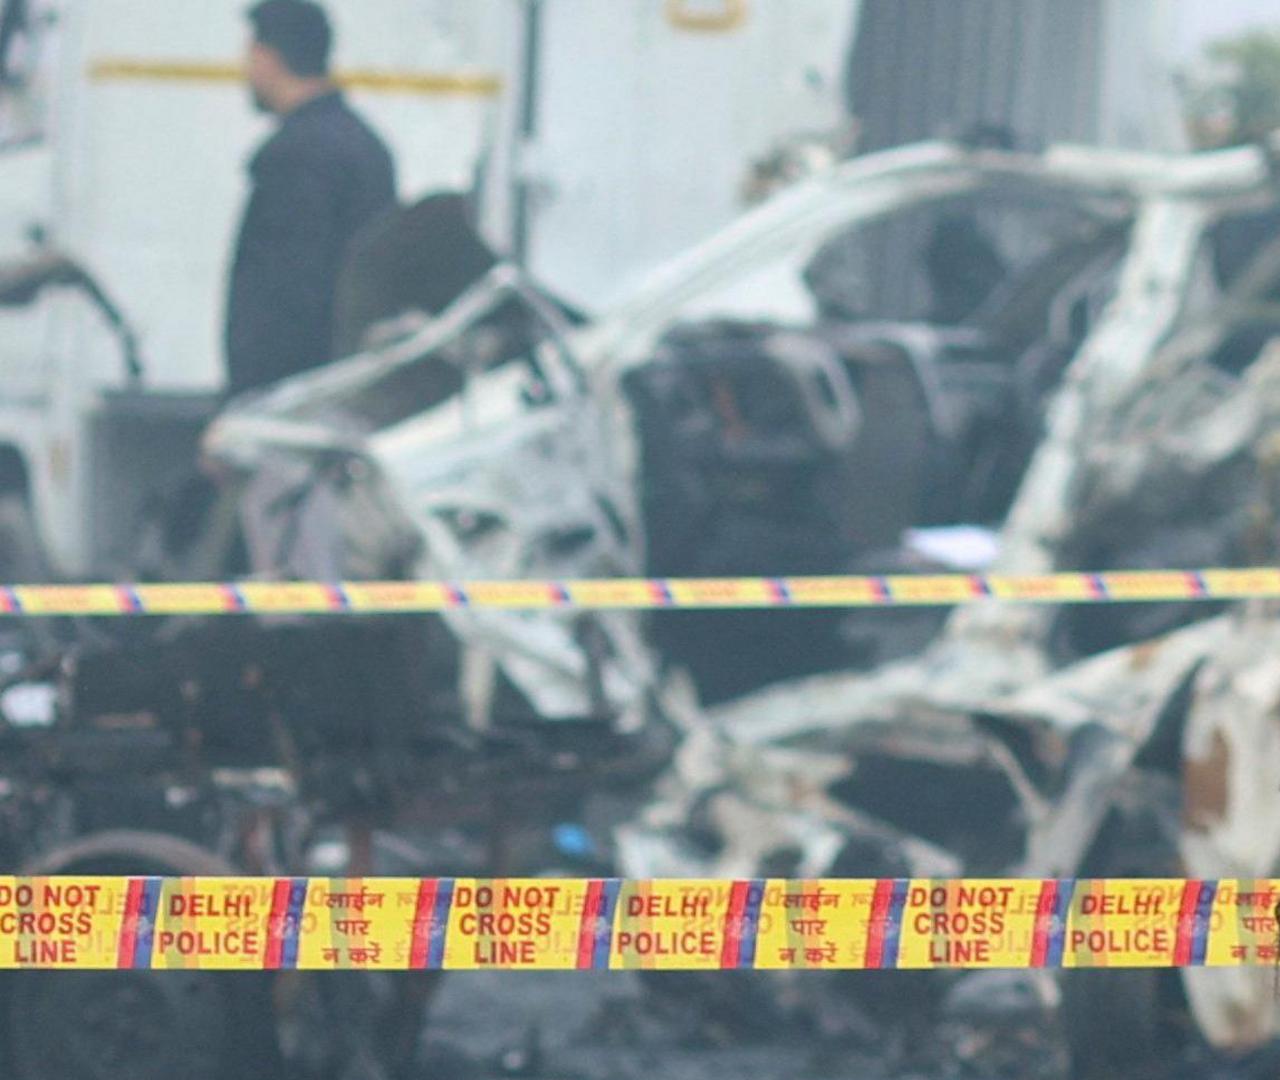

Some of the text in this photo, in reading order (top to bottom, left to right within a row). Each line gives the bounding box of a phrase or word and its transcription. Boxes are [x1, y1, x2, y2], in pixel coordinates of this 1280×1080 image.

[0, 885, 101, 907] DO NOT
[169, 894, 251, 917] DELHI
[456, 886, 560, 908] DO NOT
[626, 895, 709, 918] DELHI
[910, 886, 1014, 908] DO NOT
[1080, 894, 1163, 916] DELHI
[0, 913, 92, 935] CROSS
[335, 919, 372, 935] पार
[459, 913, 551, 936] CROSS
[791, 919, 828, 935] पार
[913, 913, 1005, 936] CROSS
[14, 941, 77, 963] LINE
[159, 931, 259, 955] POLICE
[474, 940, 536, 963] LINE
[617, 931, 716, 954] POLICE
[928, 940, 991, 962] LINE
[1070, 930, 1169, 953] POLICE
[322, 947, 340, 963] न
[778, 947, 796, 963] न
